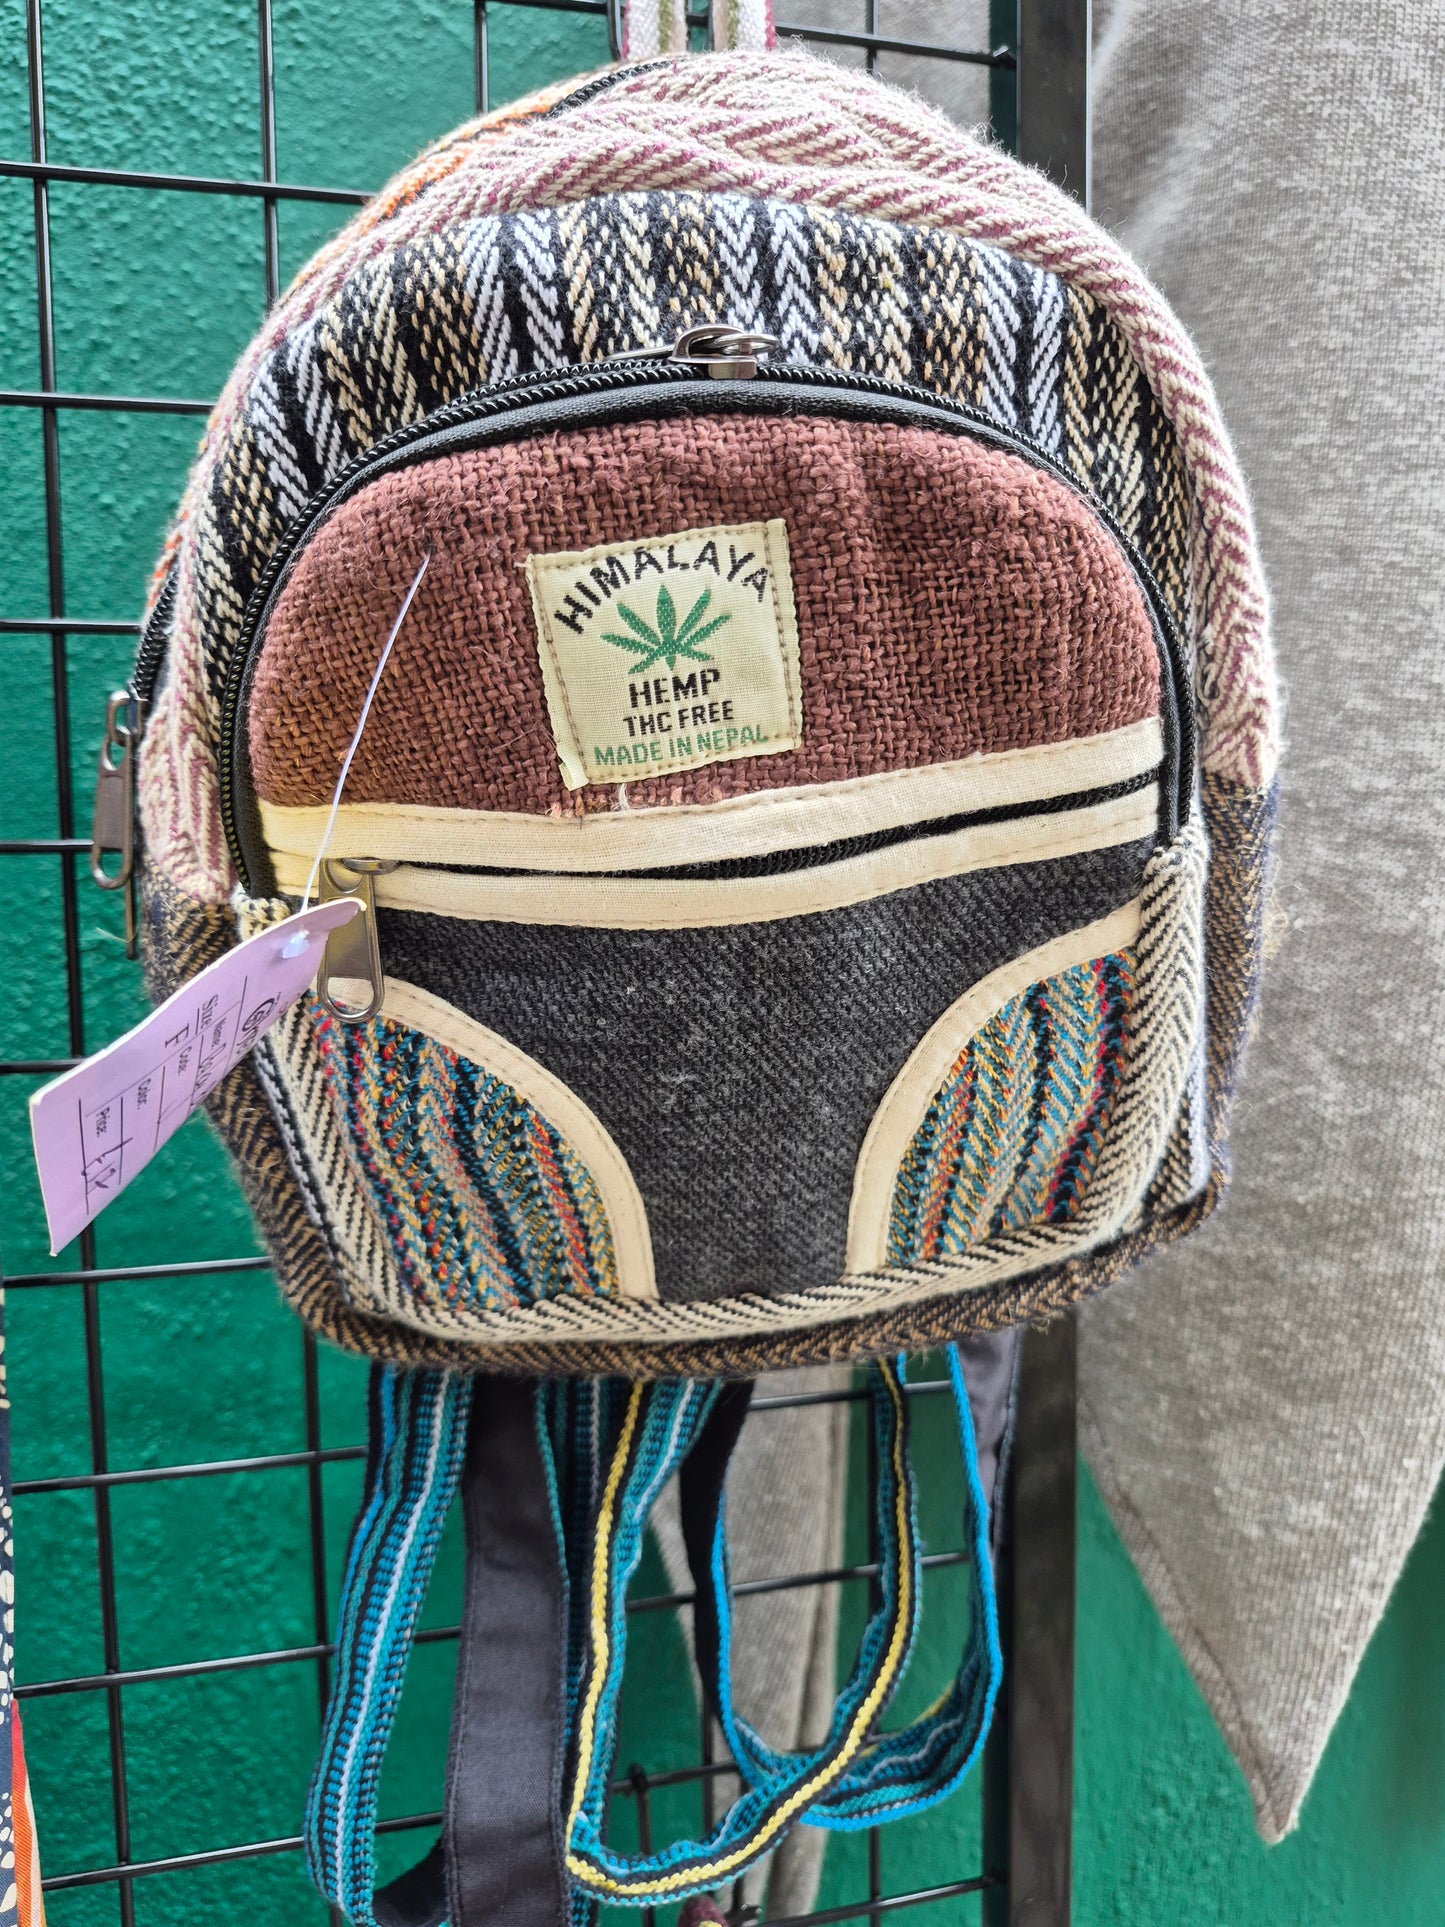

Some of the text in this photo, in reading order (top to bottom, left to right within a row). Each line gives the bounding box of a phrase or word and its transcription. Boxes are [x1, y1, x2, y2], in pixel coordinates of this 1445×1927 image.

[554, 540, 769, 634] HIMALAYA
[628, 668, 720, 708] HEMP
[623, 700, 735, 737] THC FREE
[594, 724, 768, 767] MADE IN NEPAL
